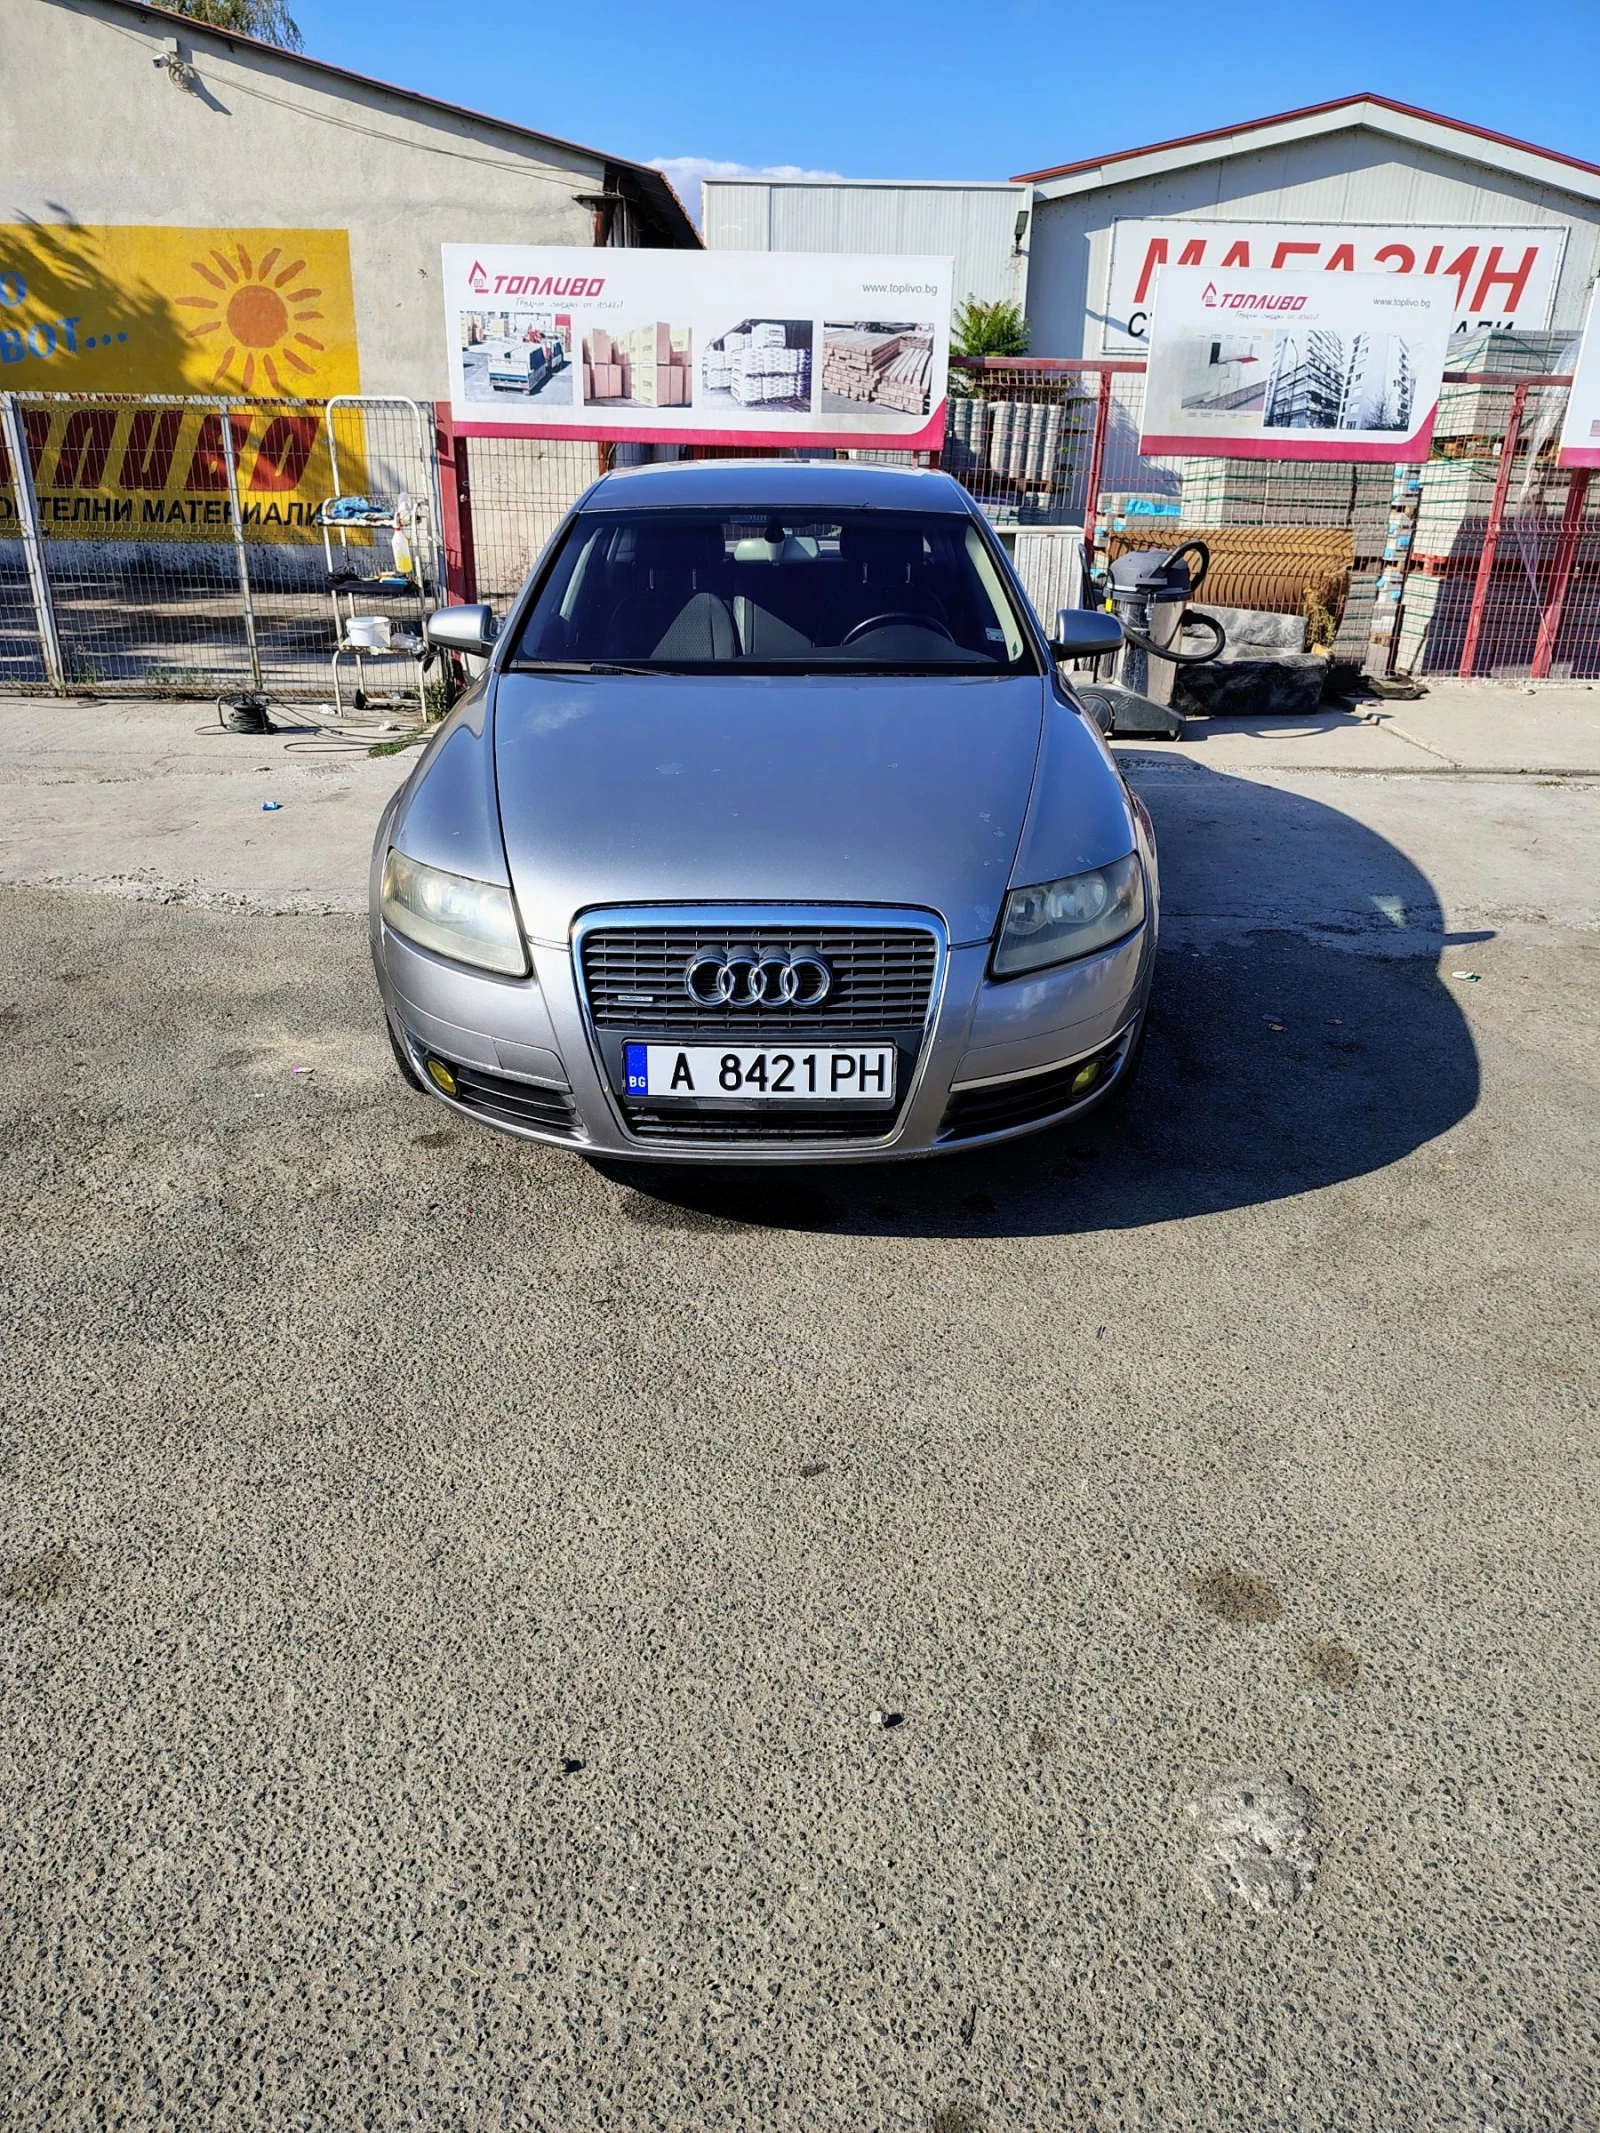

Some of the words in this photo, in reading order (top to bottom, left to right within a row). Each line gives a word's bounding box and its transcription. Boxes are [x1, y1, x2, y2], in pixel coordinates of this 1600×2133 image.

[494, 275, 606, 297] ТОПЛИВО
[862, 283, 938, 296] www.toplivo.bg
[1220, 293, 1309, 311] ТОПЛИВО
[1373, 297, 1431, 309] www.toplivo.bg
[0, 497, 133, 522] ТЕЛНИ
[629, 1075, 646, 1088] BG
